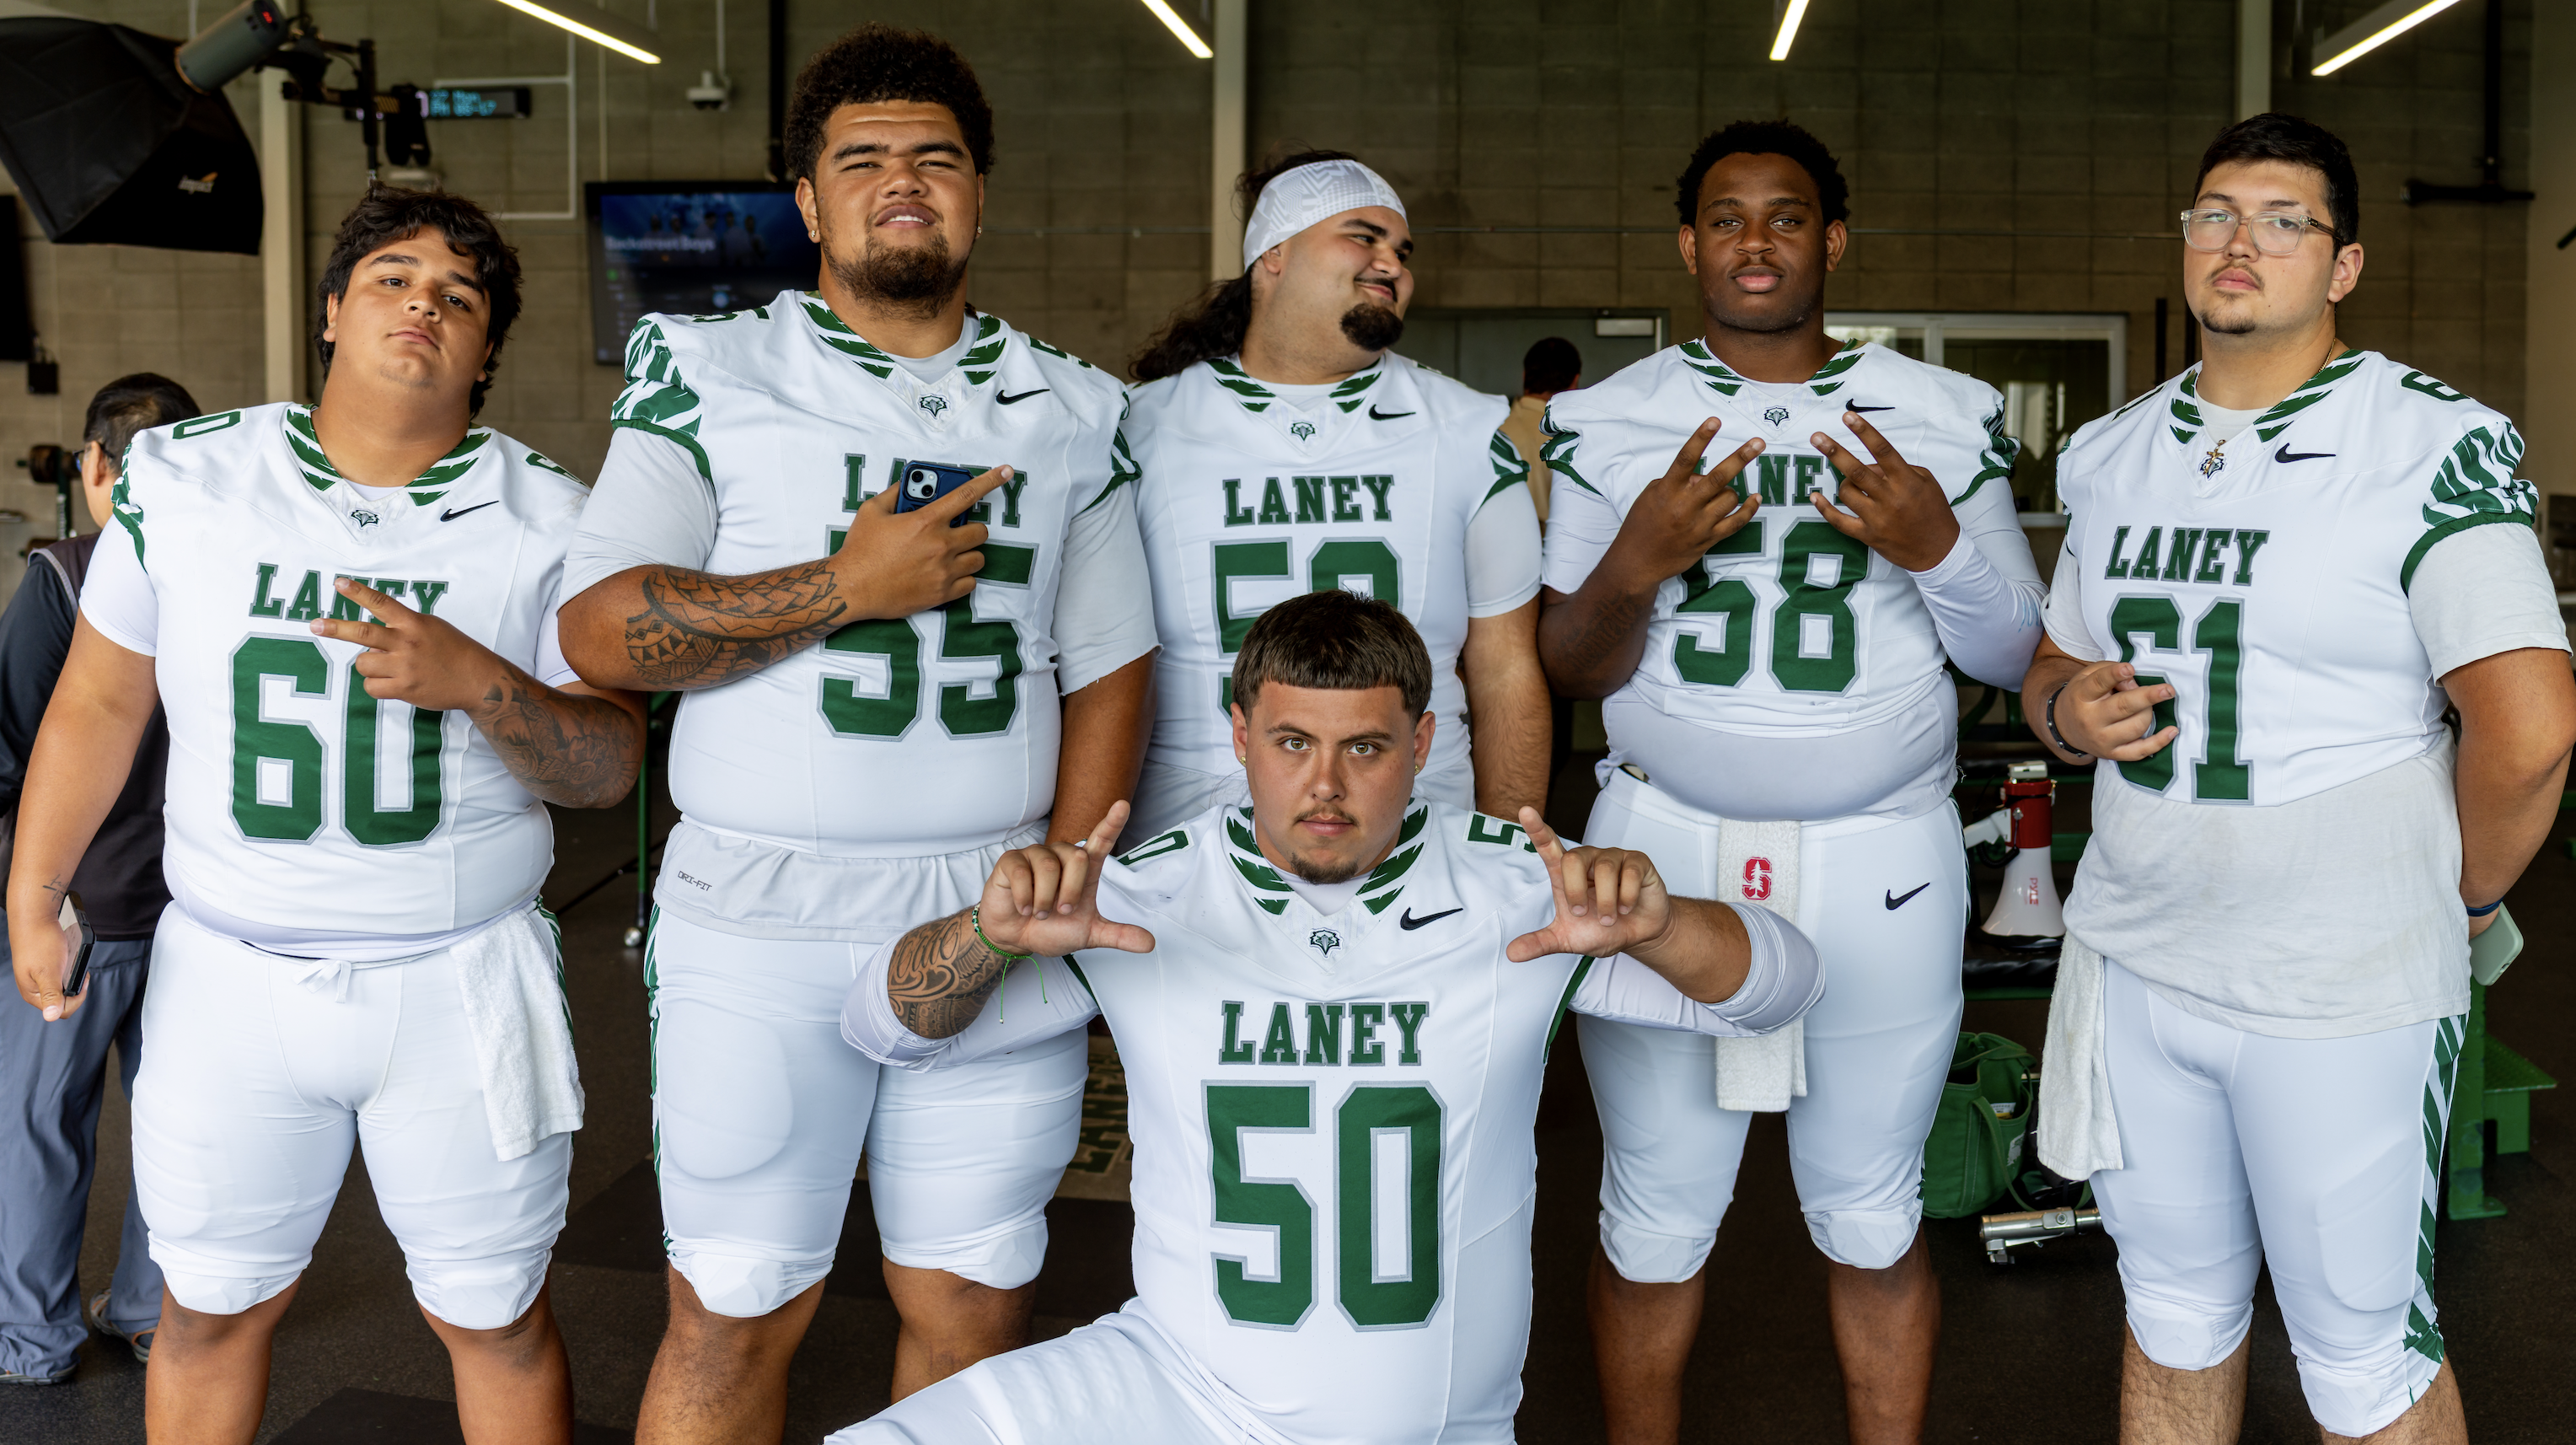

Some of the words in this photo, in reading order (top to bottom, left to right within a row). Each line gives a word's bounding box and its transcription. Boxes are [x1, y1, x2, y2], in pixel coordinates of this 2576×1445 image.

[1222, 475, 1395, 528] LANEY
[2105, 525, 2270, 587] LANEY
[817, 524, 1039, 742] 55
[1670, 517, 1873, 697] 58
[228, 631, 451, 850] 60
[2106, 593, 2255, 806] 61
[678, 870, 712, 892] DRI-FIT
[1218, 1000, 1430, 1066] LANEY
[1200, 1079, 1448, 1332] 50
